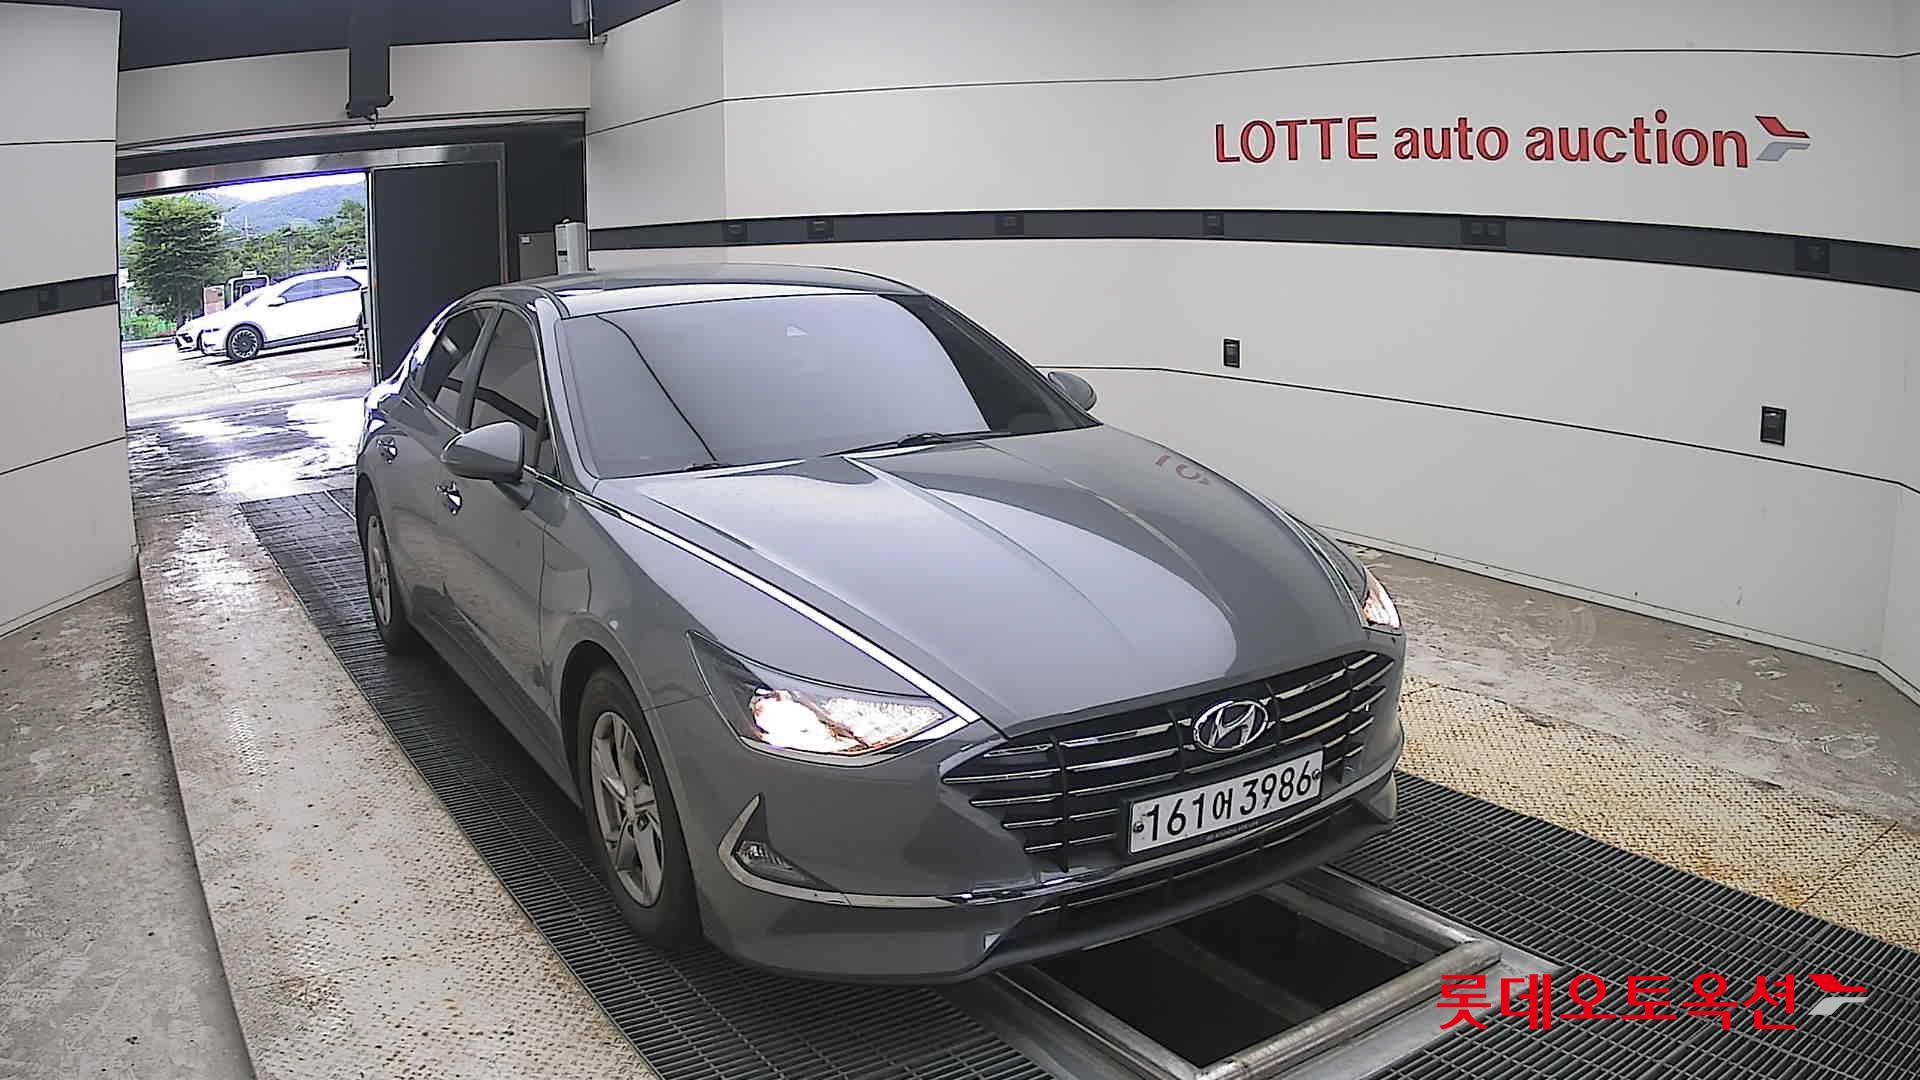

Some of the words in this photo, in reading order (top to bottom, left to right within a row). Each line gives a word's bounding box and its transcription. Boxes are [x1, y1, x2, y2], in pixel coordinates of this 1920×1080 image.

[1215, 116, 1378, 163] LOTTE
[1394, 117, 1510, 161] auto
[1525, 109, 1750, 168] auction
